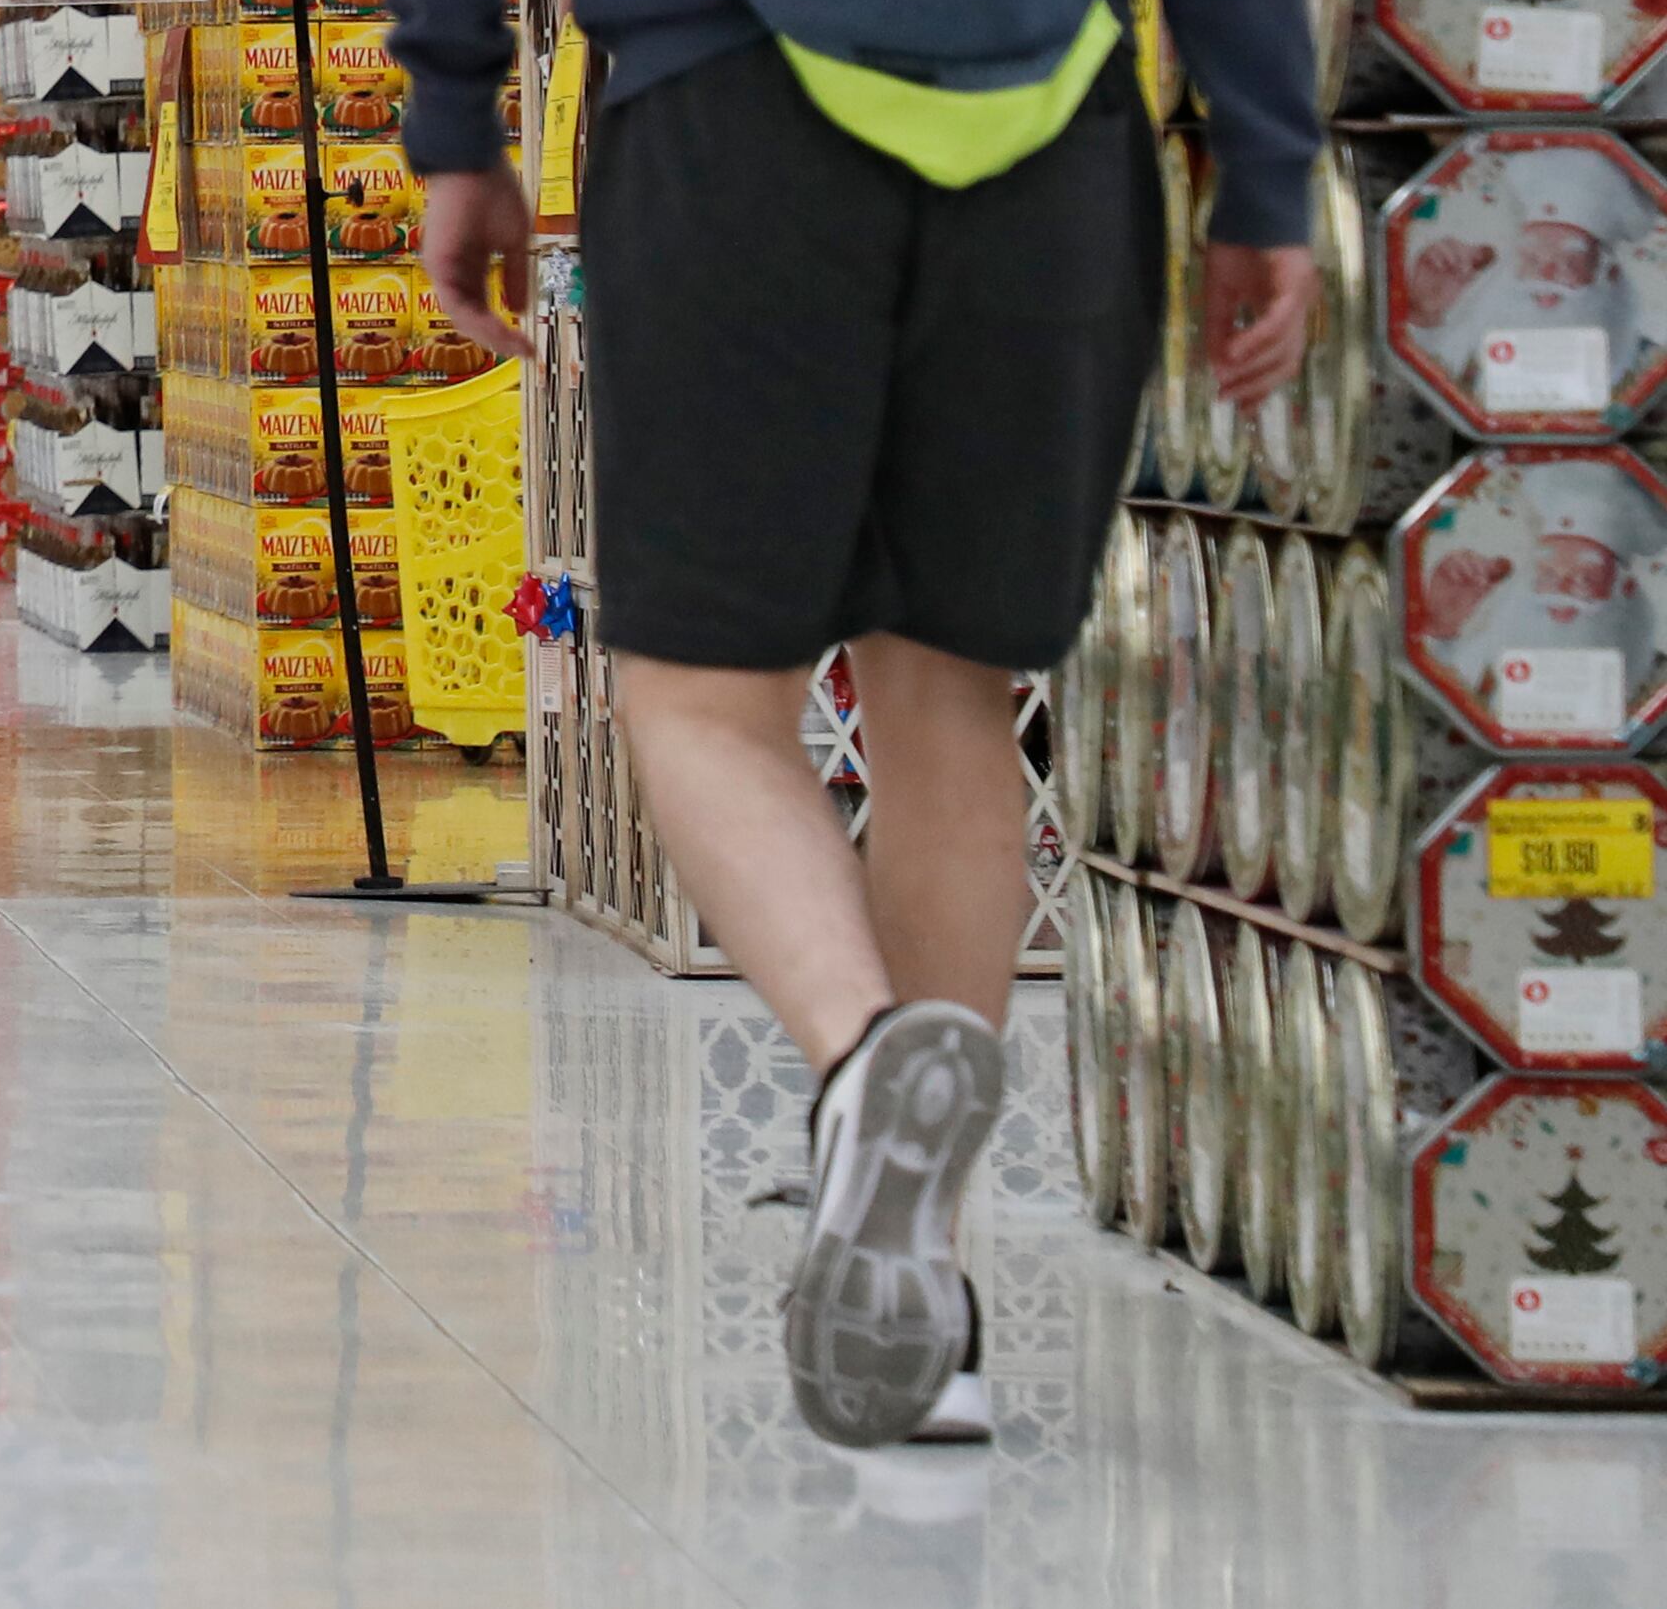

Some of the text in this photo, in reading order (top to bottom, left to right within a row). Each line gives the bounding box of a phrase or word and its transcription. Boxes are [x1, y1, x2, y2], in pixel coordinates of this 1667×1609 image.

[328, 47, 399, 69] MAIZENA
[333, 167, 405, 190] MAIZENA
[336, 291, 407, 313] MAIZENA
[261, 535, 333, 557] MAIZENA
[263, 656, 334, 678] MAIZENA
